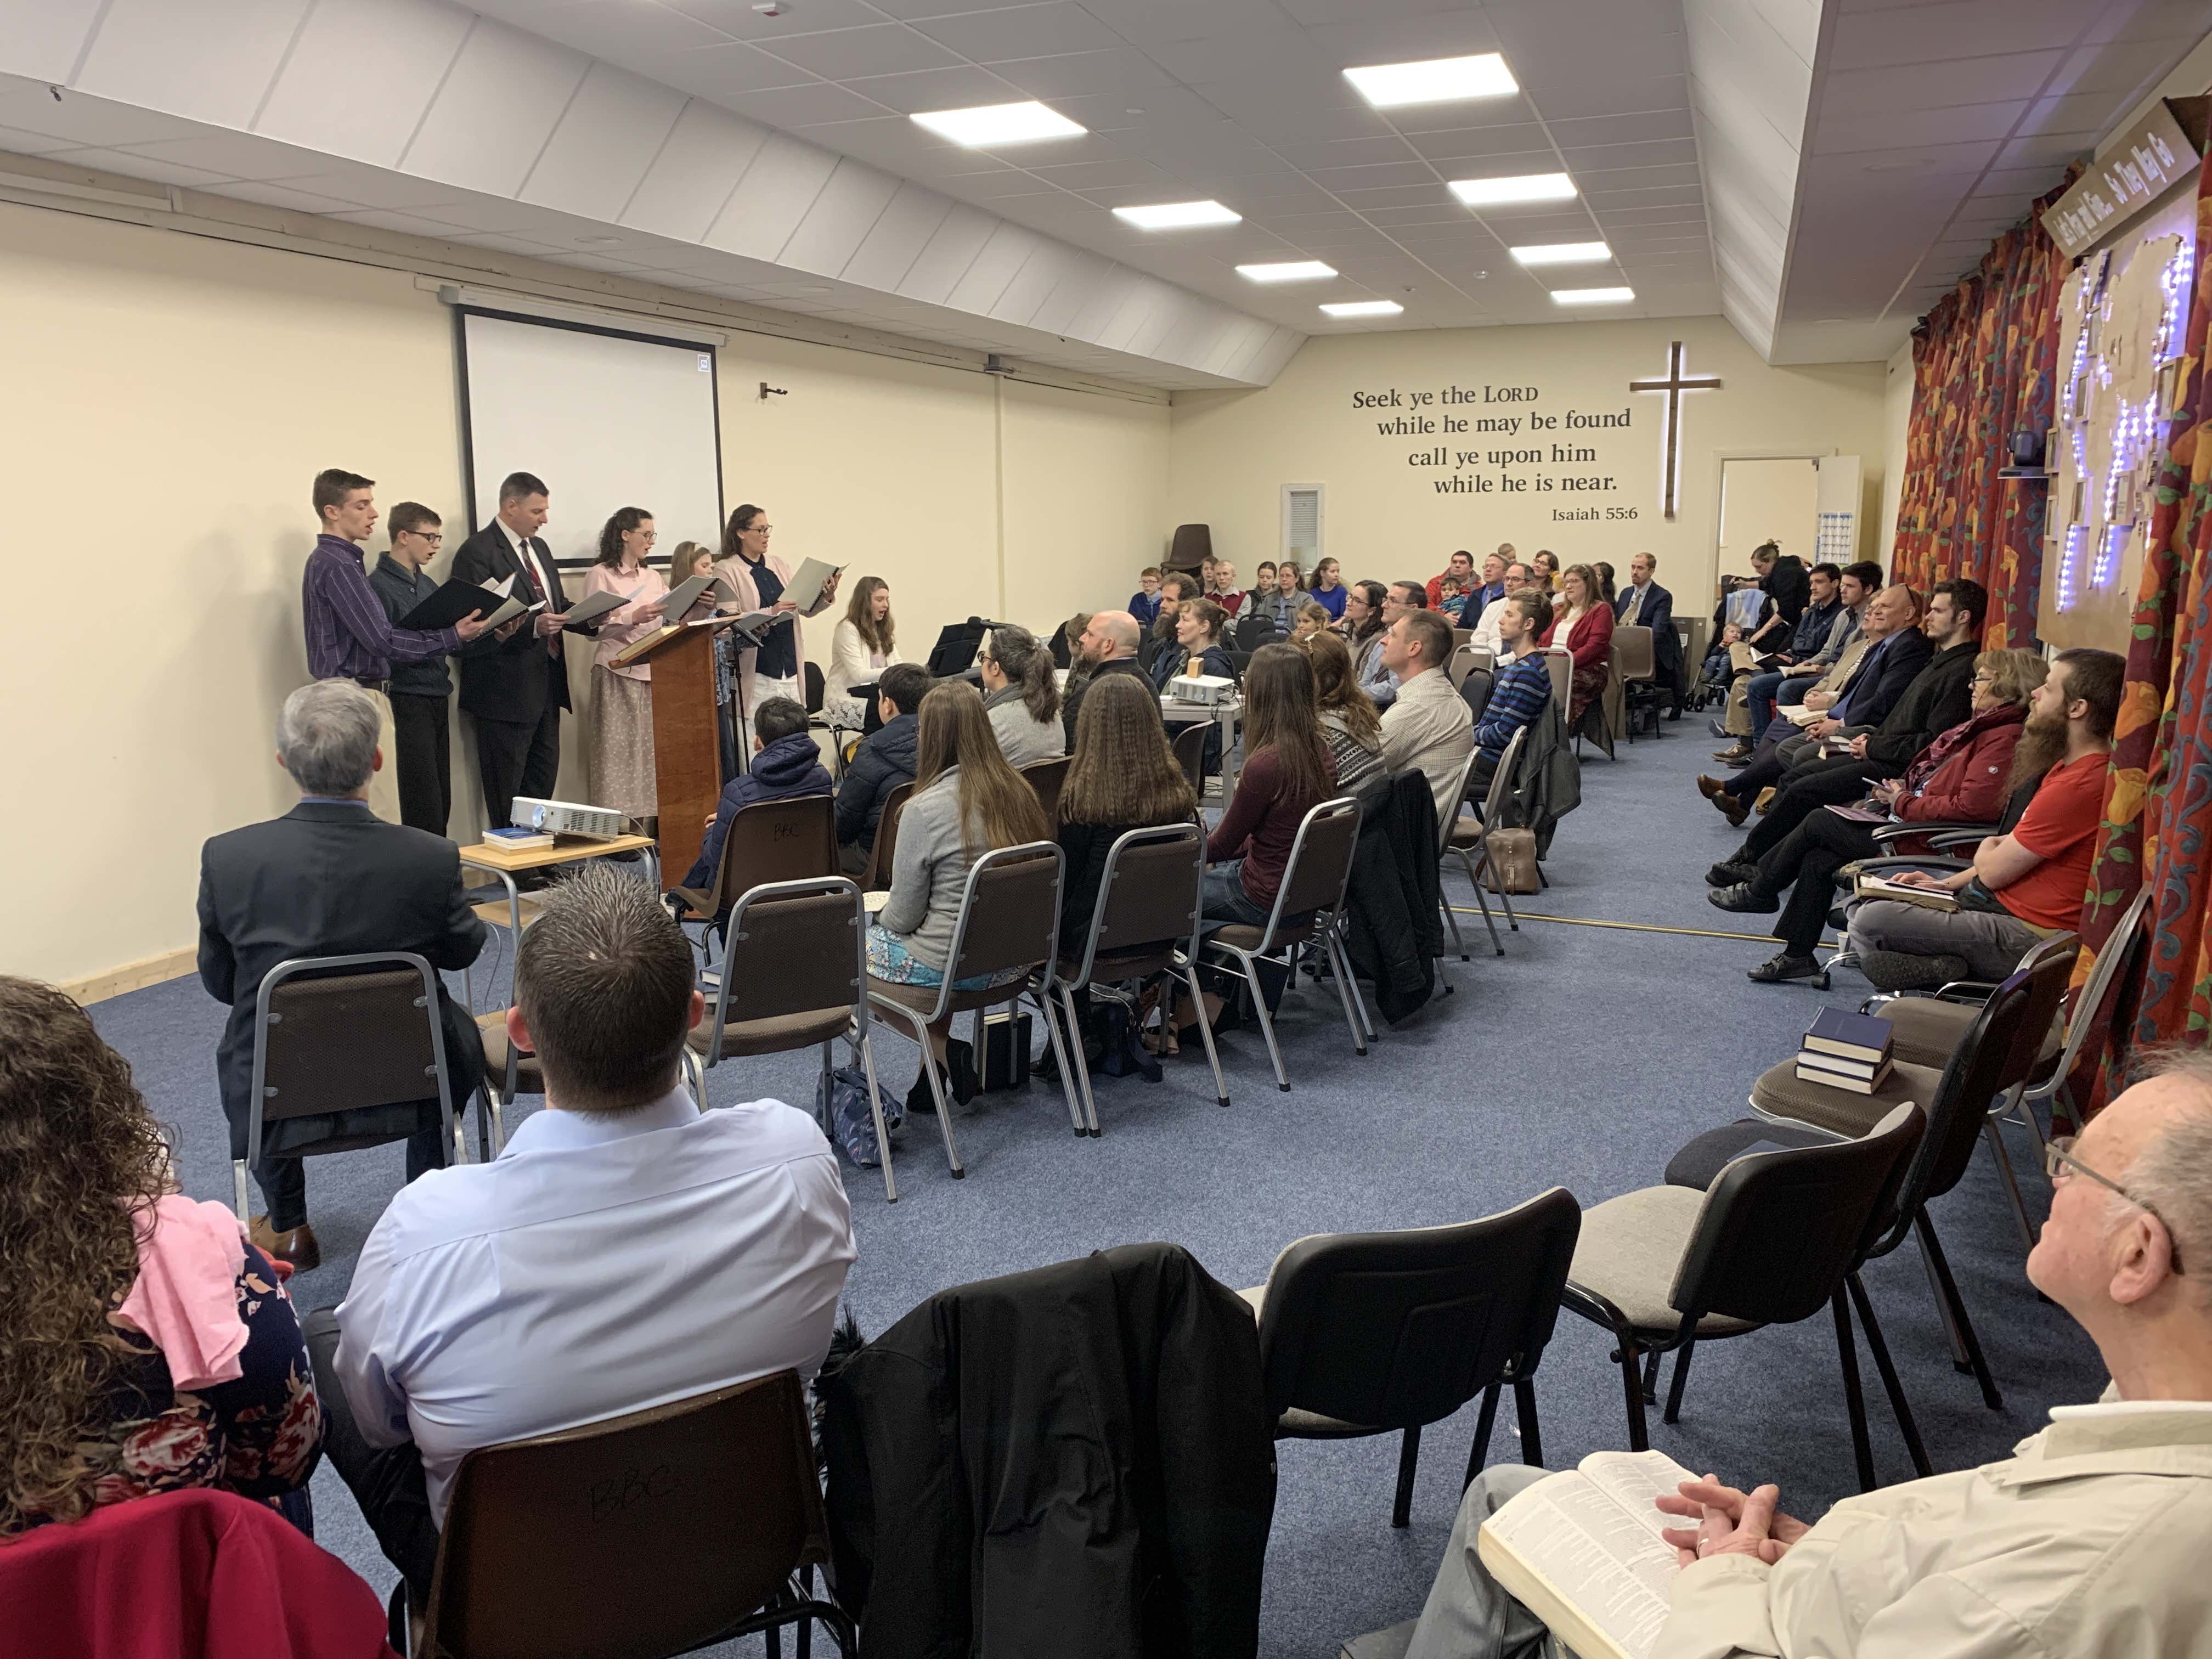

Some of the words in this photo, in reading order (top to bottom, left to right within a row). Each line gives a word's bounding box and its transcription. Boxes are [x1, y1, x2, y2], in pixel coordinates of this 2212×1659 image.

[1353, 388, 1403, 409] Seek
[1409, 392, 1433, 411] ye
[1441, 386, 1476, 404] the
[1483, 386, 1538, 403] LORD
[1376, 416, 1435, 436] while
[1443, 414, 1468, 433] he
[1476, 417, 1522, 436] may
[1530, 411, 1557, 430] be
[1565, 408, 1631, 429] found
[1408, 447, 1447, 466] call
[1455, 452, 1479, 470] ye
[1487, 450, 1543, 469] upon
[1551, 443, 1596, 462] him
[1434, 474, 1493, 493] while
[1502, 473, 1527, 492] he
[1535, 473, 1553, 492] is
[1561, 477, 1617, 491] near.
[1553, 507, 1599, 521] Isaiah
[1606, 507, 1638, 520] 55:6
[774, 822, 800, 842] BBC
[590, 1464, 683, 1523] BBC
